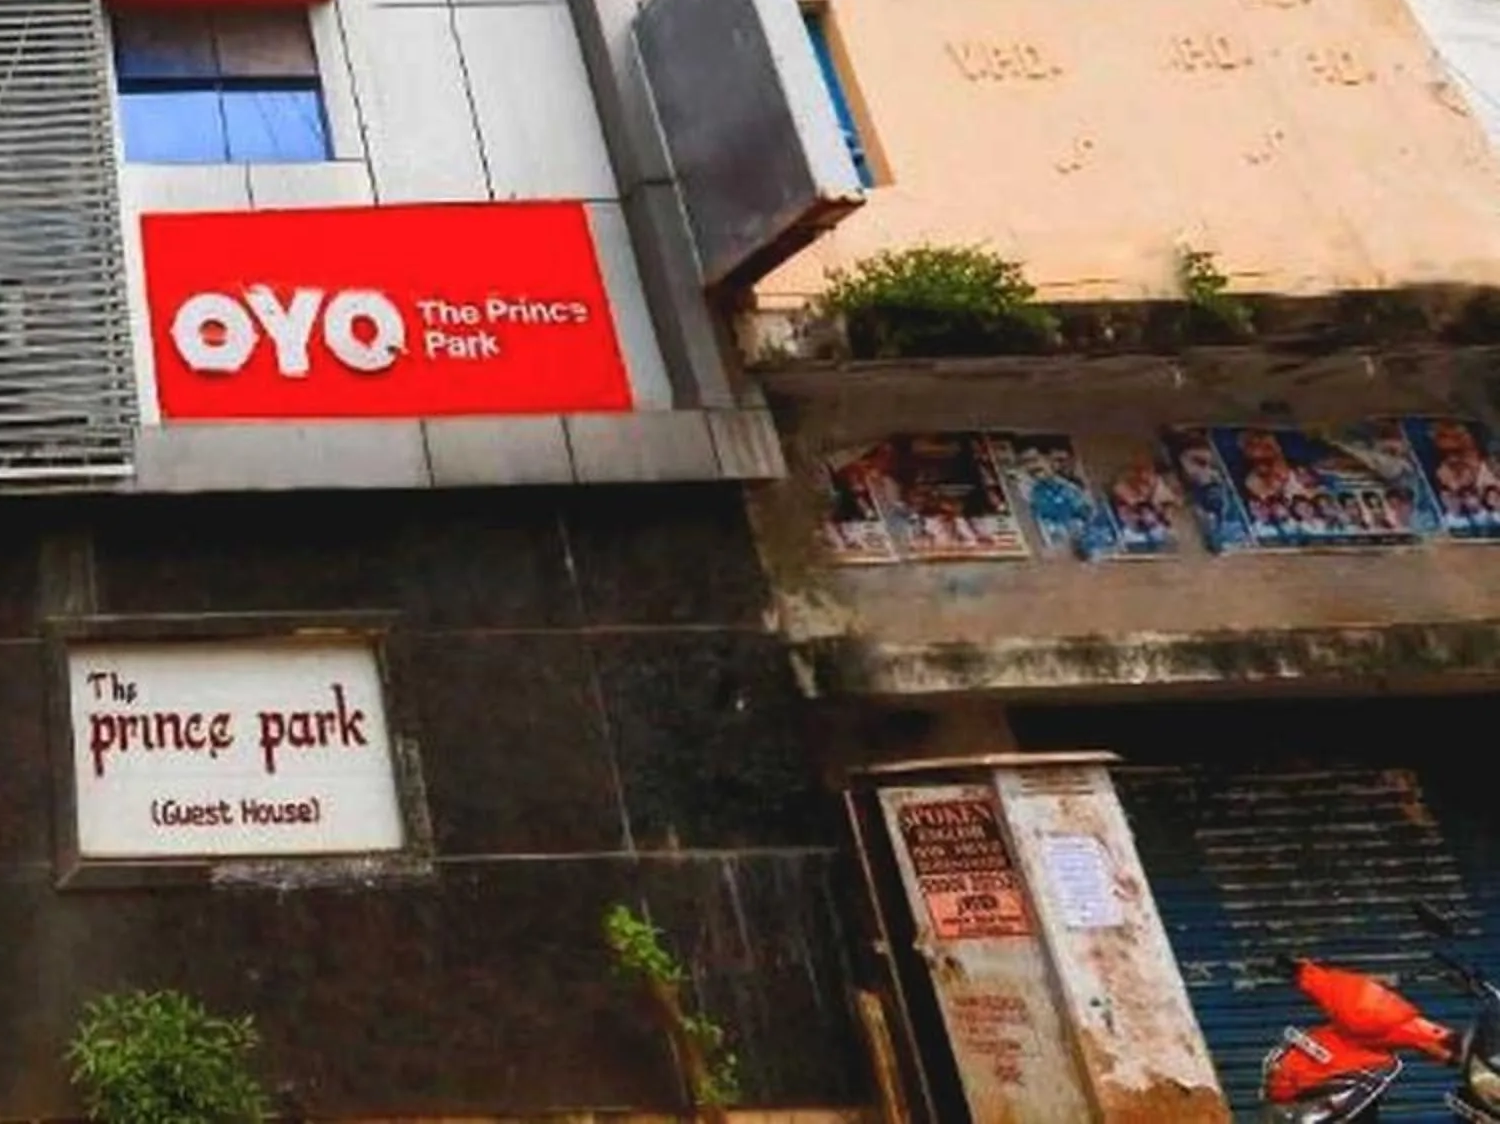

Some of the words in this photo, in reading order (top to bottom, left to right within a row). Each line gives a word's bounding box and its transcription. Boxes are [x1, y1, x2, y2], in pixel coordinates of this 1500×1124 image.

[417, 298, 479, 325] The
[486, 298, 589, 324] Prince
[171, 284, 407, 378] OYO
[424, 330, 501, 359] Park
[87, 672, 138, 705] The
[88, 709, 234, 777] prince
[257, 682, 368, 774] park
[150, 798, 234, 827] (Guest
[240, 796, 320, 827] House)
